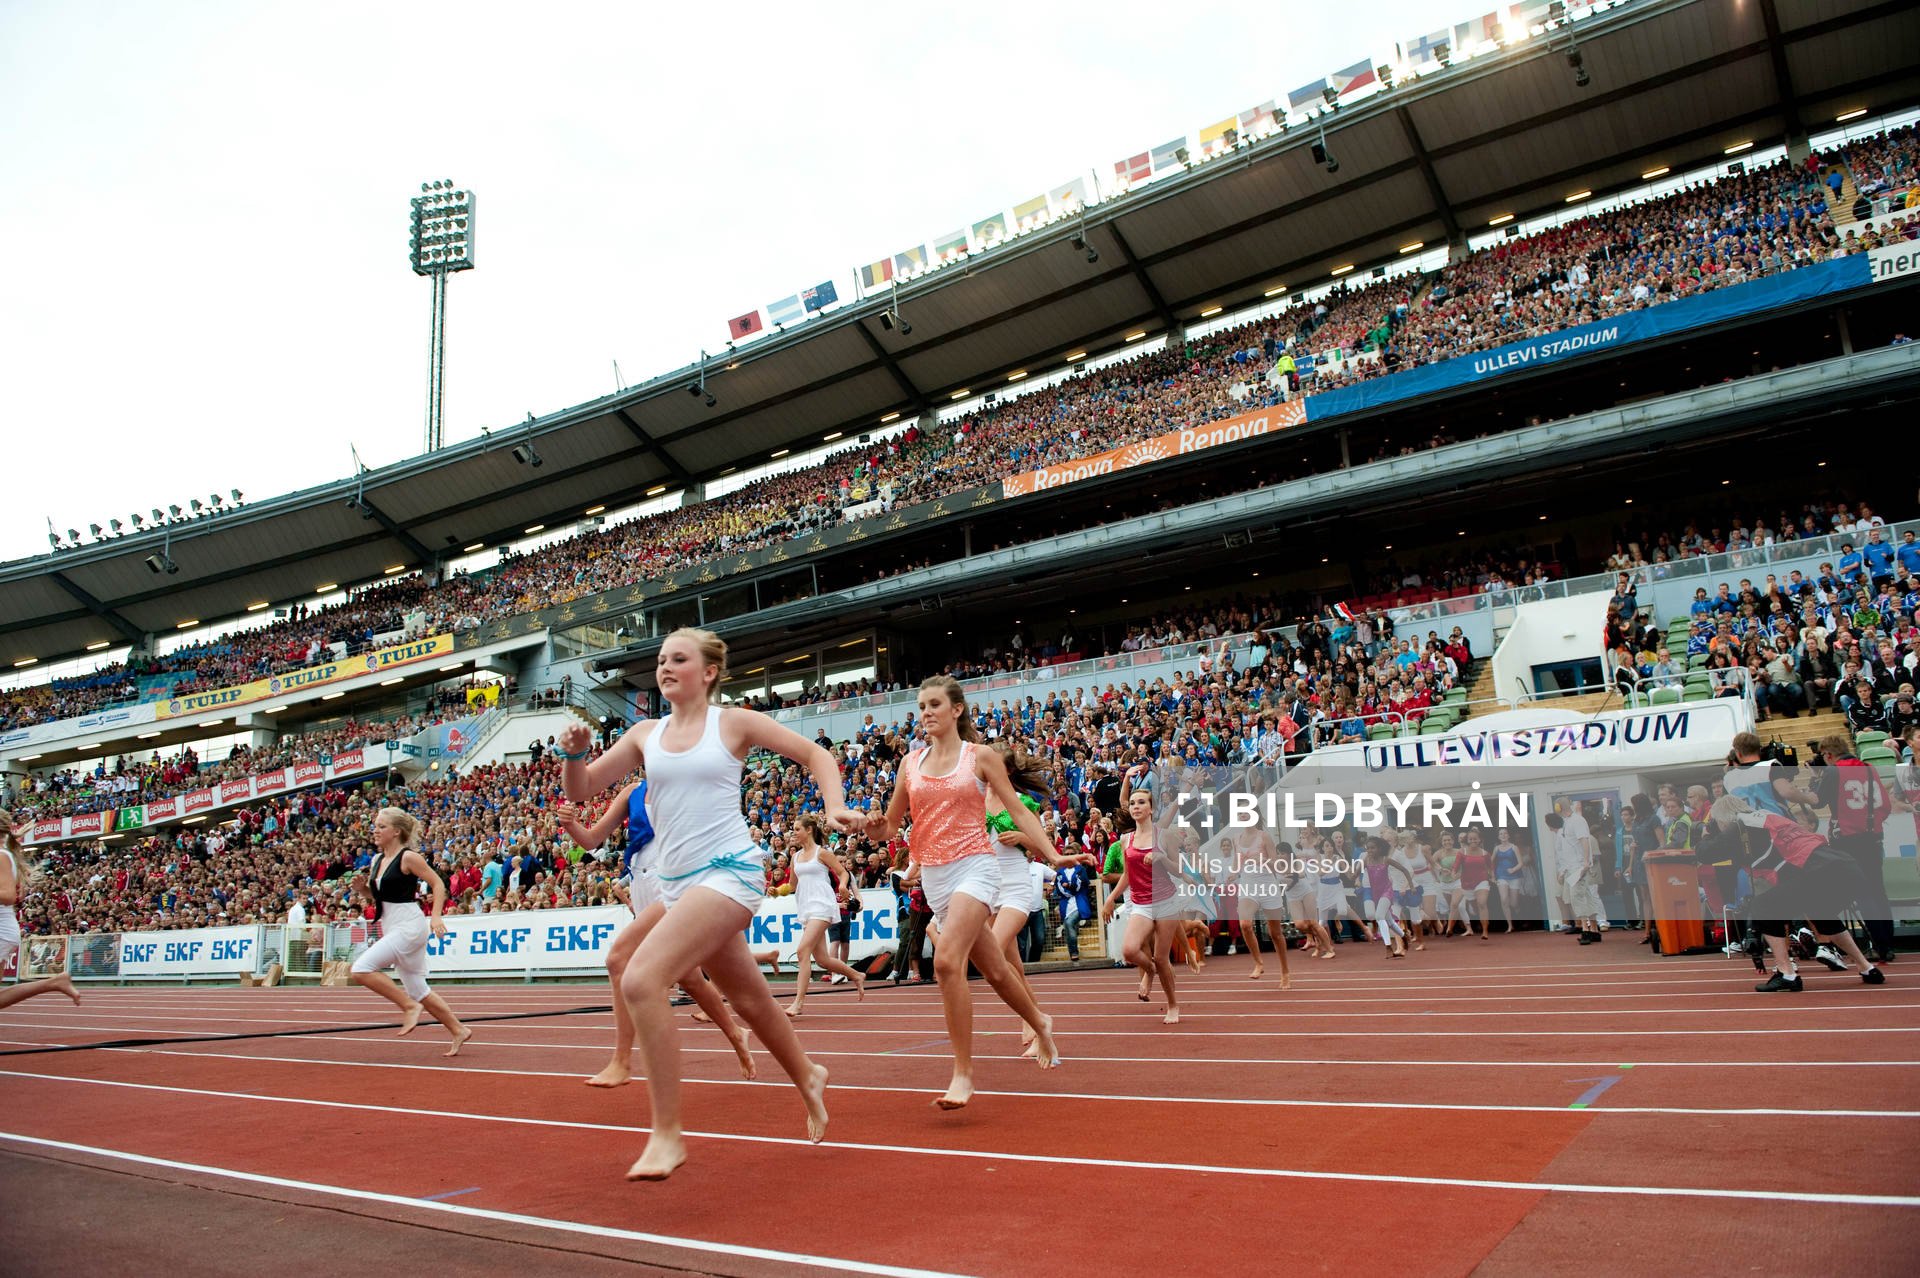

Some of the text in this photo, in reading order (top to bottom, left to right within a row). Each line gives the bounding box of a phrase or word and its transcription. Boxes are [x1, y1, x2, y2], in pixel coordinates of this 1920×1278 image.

[1474, 326, 1618, 374] ULLEVI STADIUM
[1179, 416, 1269, 455] Renova
[1033, 456, 1113, 492] Renova
[380, 640, 437, 664] TULIP
[282, 665, 337, 688] TULIP
[184, 689, 242, 710] TULIP
[1363, 711, 1690, 773] ULLEVI STADIUM
[295, 764, 324, 779] GEVALIA
[333, 754, 363, 770] GEVALIA
[222, 783, 249, 797] GEVALIA
[257, 774, 286, 788] GEVALIA
[149, 802, 176, 817] GEVALIA
[185, 792, 212, 807] GEVALIA
[34, 823, 61, 836] GEVALIA
[72, 817, 100, 829] GEVALIA
[545, 923, 615, 952] SKF
[744, 913, 803, 945] KF
[164, 941, 204, 962] SKF
[211, 939, 253, 961] SKF
[470, 927, 531, 955] SKF
[123, 943, 158, 963] SKF
